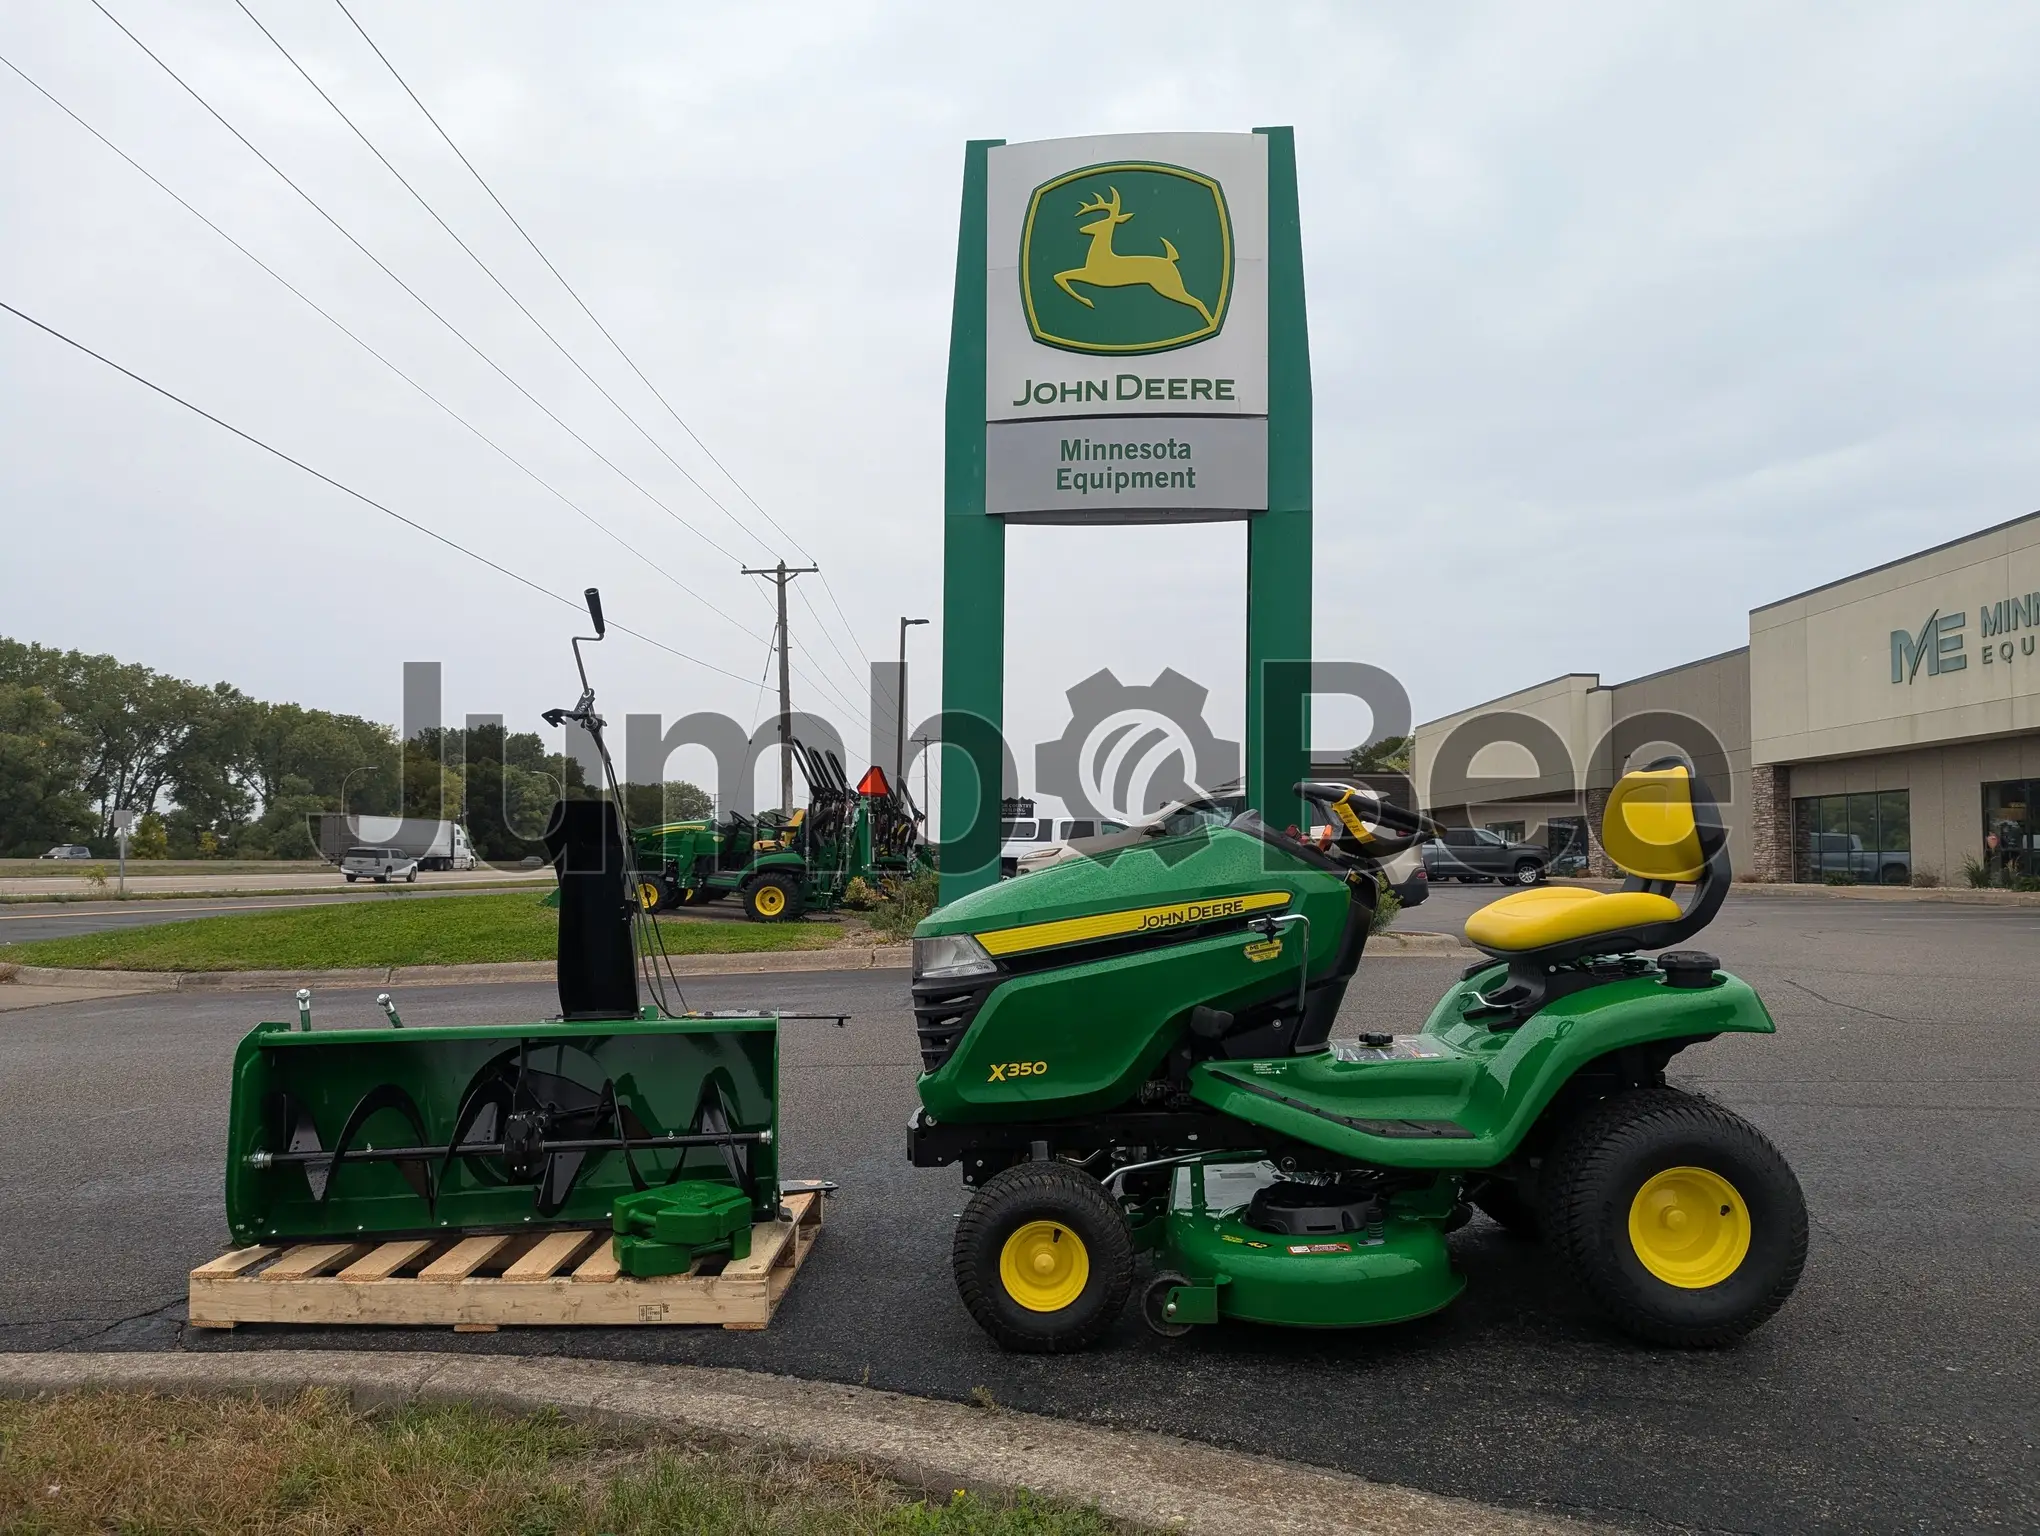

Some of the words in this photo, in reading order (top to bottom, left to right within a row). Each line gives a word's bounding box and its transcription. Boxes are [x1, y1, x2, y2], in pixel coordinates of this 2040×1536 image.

[1013, 379, 1108, 407] JOHN
[1115, 374, 1236, 401] DEERE
[1060, 438, 1192, 462] Minnesota
[1056, 467, 1196, 494] Equipment
[1137, 910, 1184, 930] JOHN
[1188, 900, 1244, 921] DEERE
[987, 1061, 1048, 1082] X350
